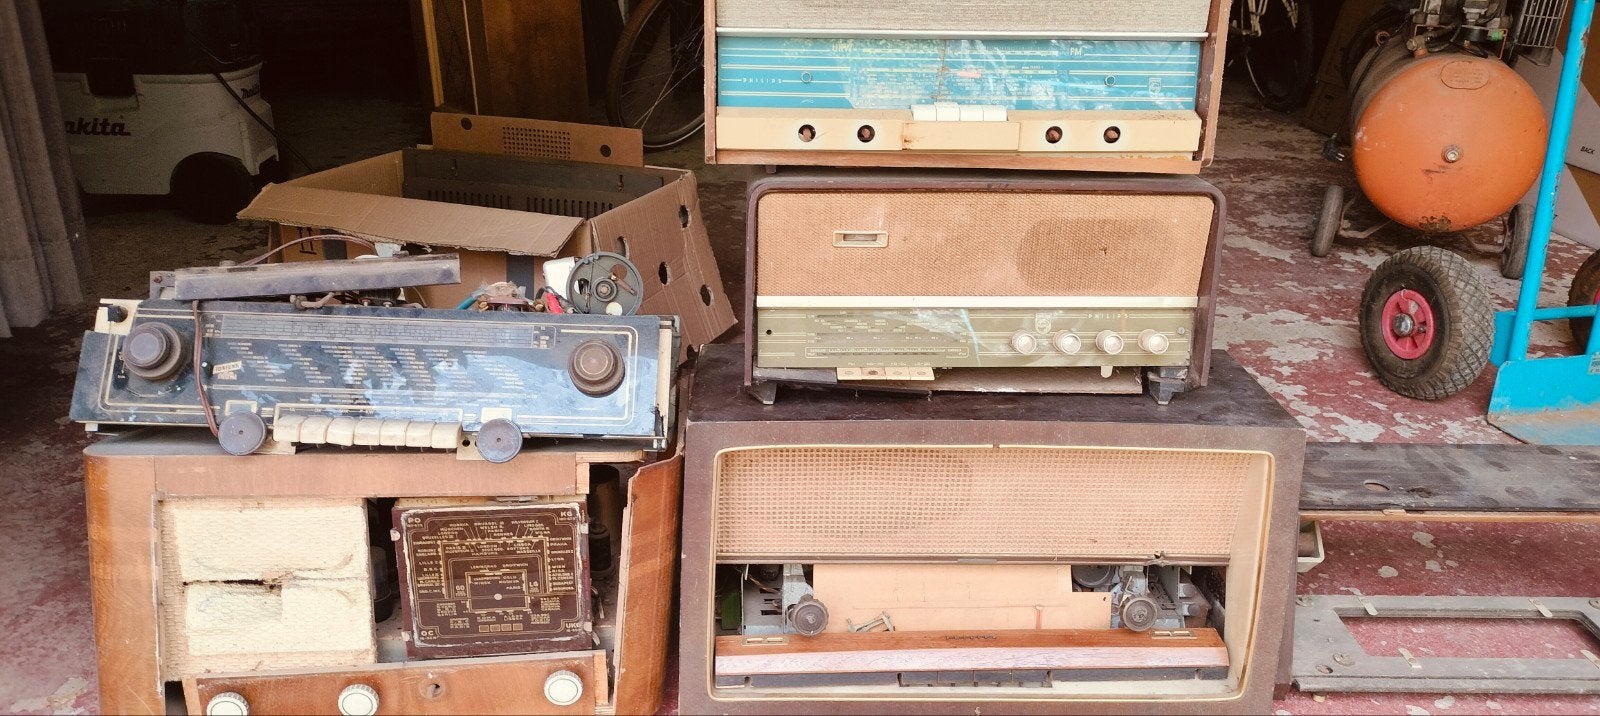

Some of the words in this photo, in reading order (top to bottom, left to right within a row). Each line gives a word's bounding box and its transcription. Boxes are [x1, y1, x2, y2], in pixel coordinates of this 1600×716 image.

[1069, 47, 1083, 56] FM
[64, 117, 131, 136] akita
[1580, 145, 1596, 155] BACK
